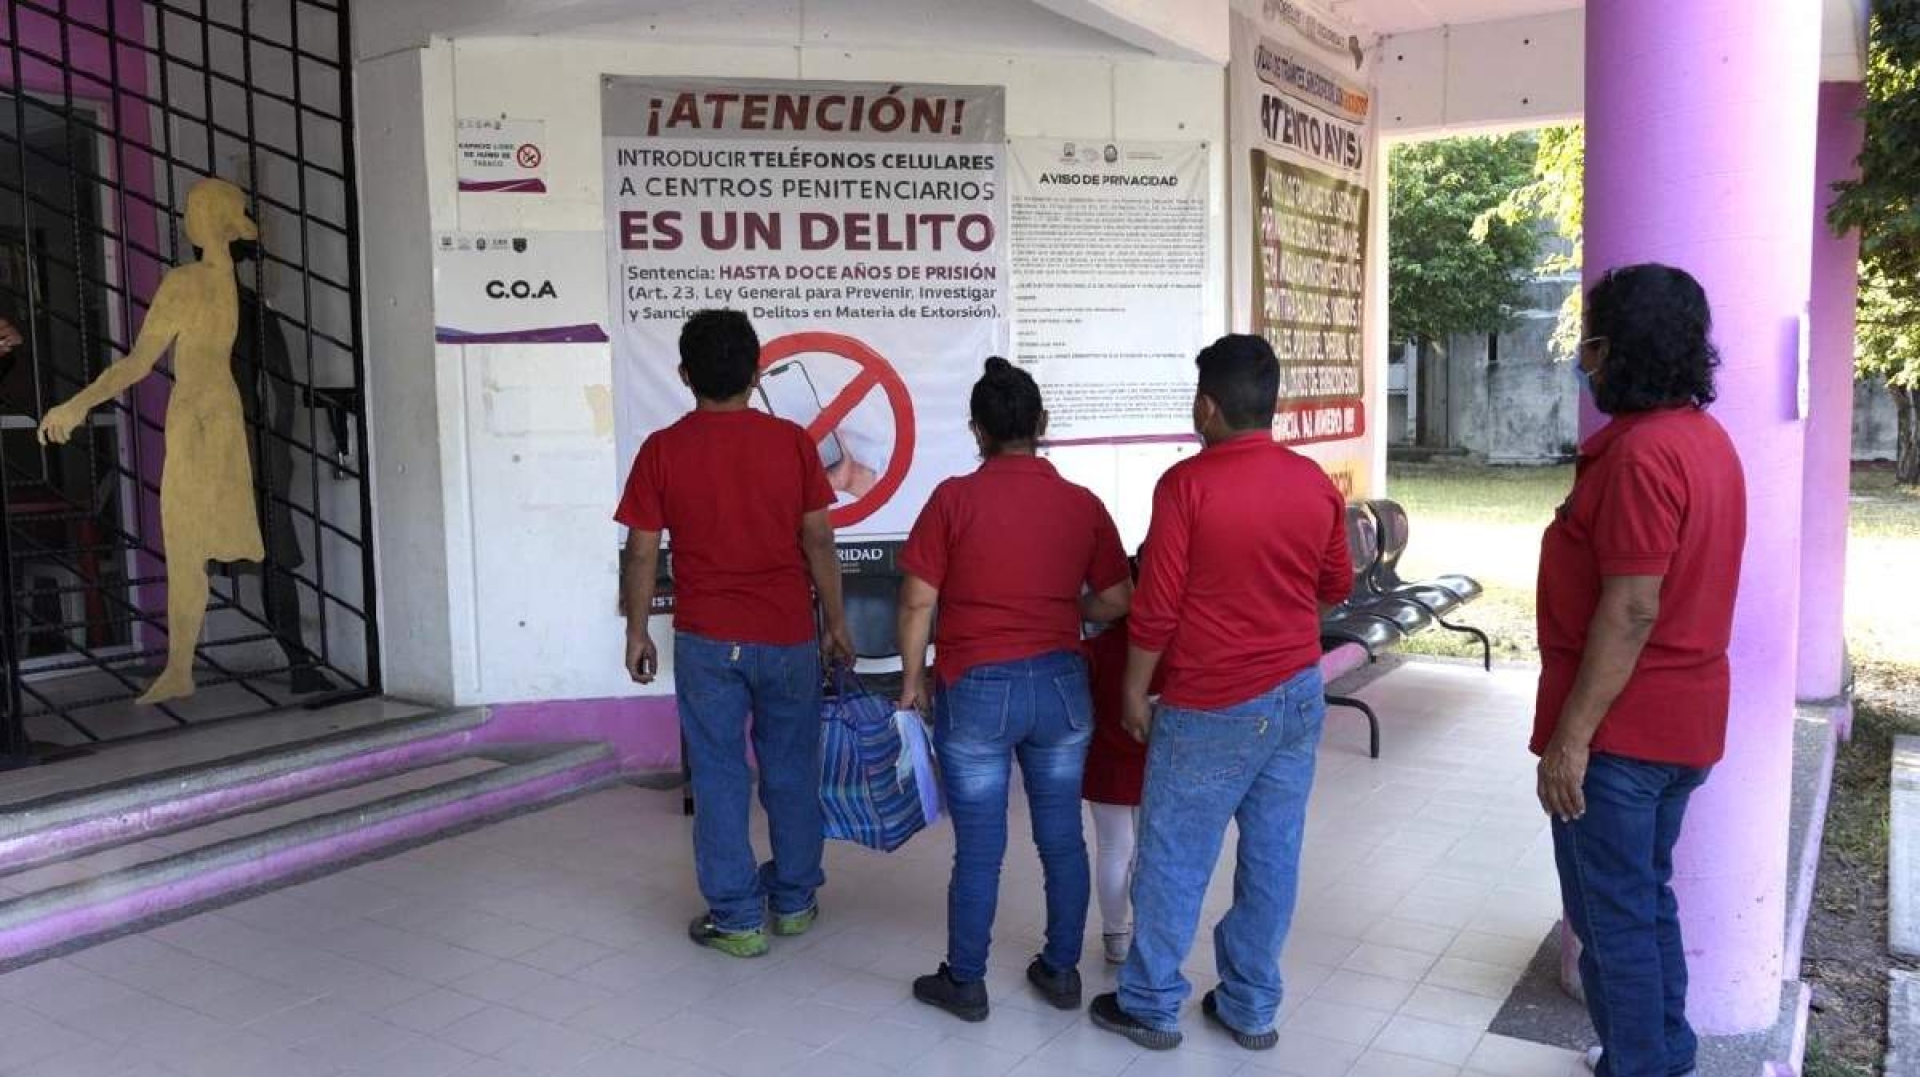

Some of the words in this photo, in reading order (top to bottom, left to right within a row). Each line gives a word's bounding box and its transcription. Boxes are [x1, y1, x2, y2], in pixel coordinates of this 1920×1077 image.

[646, 85, 965, 136] ¡ATENCIÓN!
[618, 149, 747, 168] INTRODUCIR
[750, 146, 876, 169] TELÉFONOS
[882, 153, 994, 170] CELULARES
[620, 177, 636, 197] A
[645, 177, 772, 198] CENTROS
[783, 180, 994, 200] PENITENCIARIOS
[1040, 173, 1080, 184] AVISO
[1082, 175, 1099, 184] DE
[1102, 175, 1178, 186] PRIVACIDAD
[620, 210, 683, 251] ES
[701, 212, 781, 251] UN
[800, 213, 994, 252] DELITO
[628, 265, 715, 281] Sentencia:
[719, 266, 780, 281] HASTA
[786, 266, 837, 281] DOCE
[841, 262, 892, 281] AÑOS
[899, 266, 921, 281] DE
[925, 263, 996, 281] PRISIÓN
[486, 280, 557, 299] C.O.A
[628, 285, 668, 301] (Art.
[705, 286, 731, 302] Ley
[738, 286, 800, 300] General
[806, 288, 841, 303] para
[919, 286, 996, 304] Investigar
[629, 309, 638, 322] y
[643, 306, 696, 319] Sancio
[753, 306, 809, 319] Delitos
[814, 309, 831, 319] en
[836, 307, 894, 319] Materia
[899, 306, 916, 319] de
